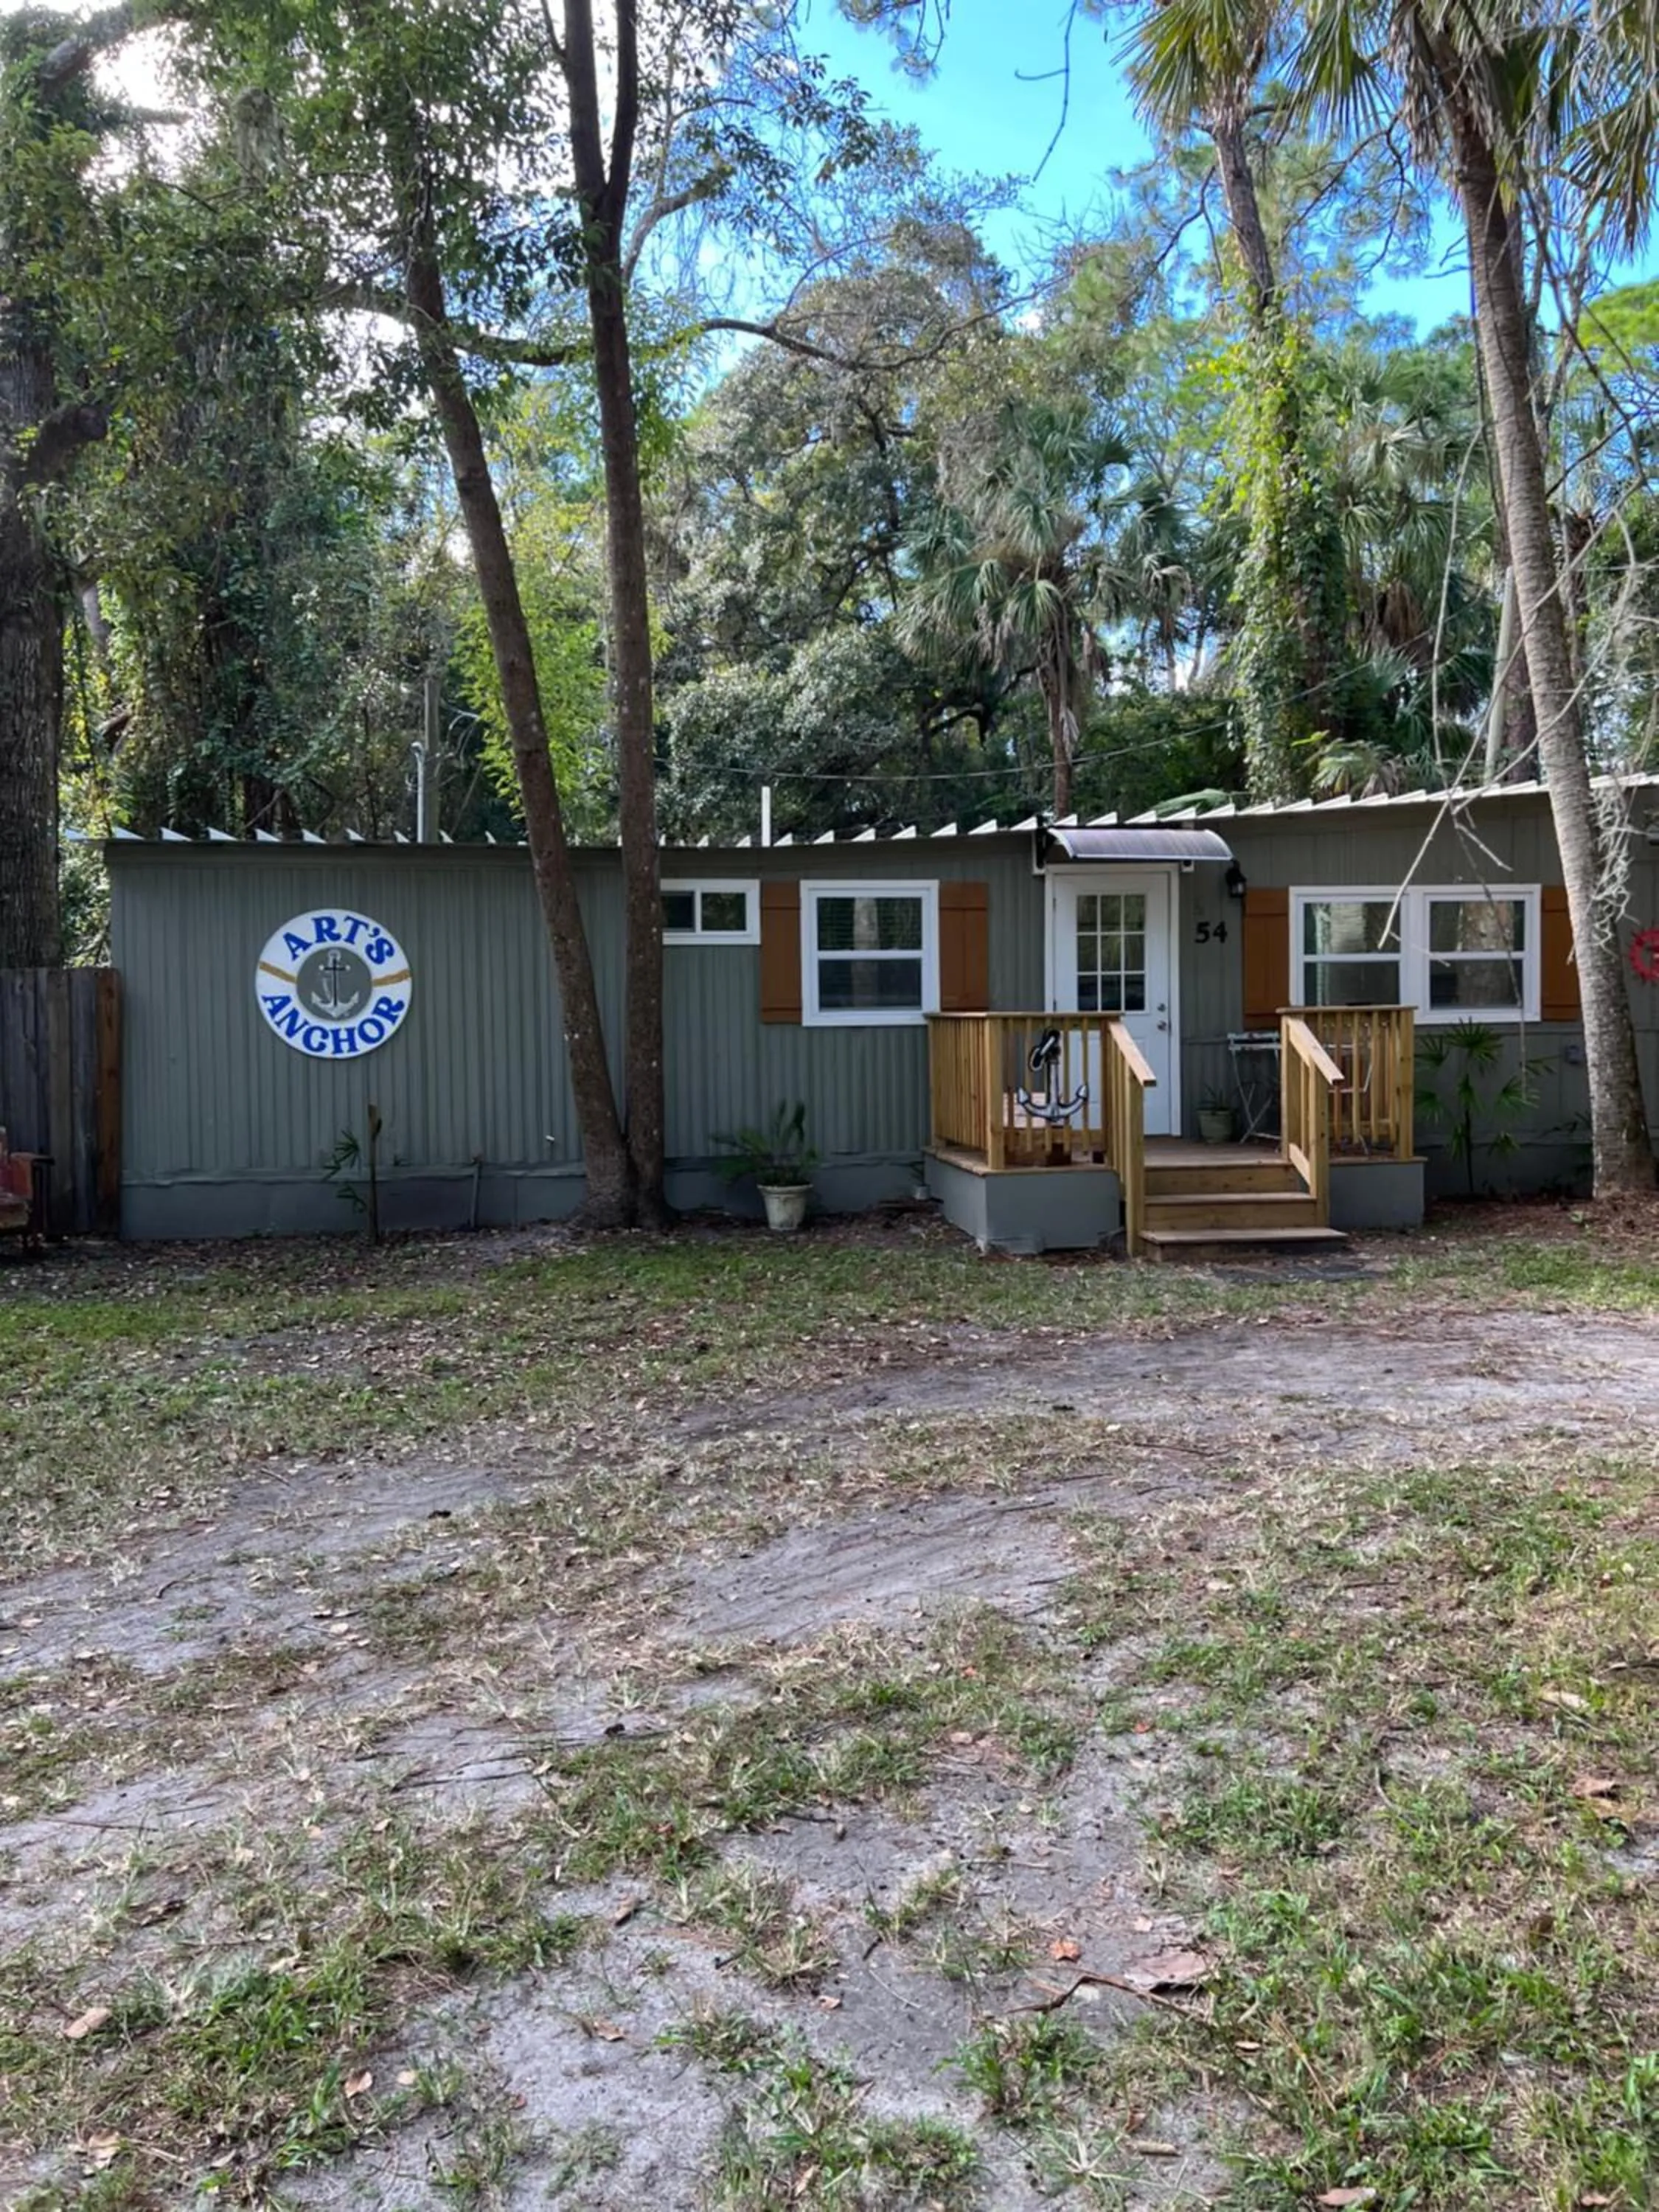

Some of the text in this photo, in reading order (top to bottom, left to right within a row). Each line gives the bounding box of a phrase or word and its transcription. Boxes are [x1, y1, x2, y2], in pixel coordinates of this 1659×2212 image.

[283, 917, 394, 964] ART'S
[1194, 921, 1228, 943] 54
[262, 995, 404, 1054] ANCHOR
